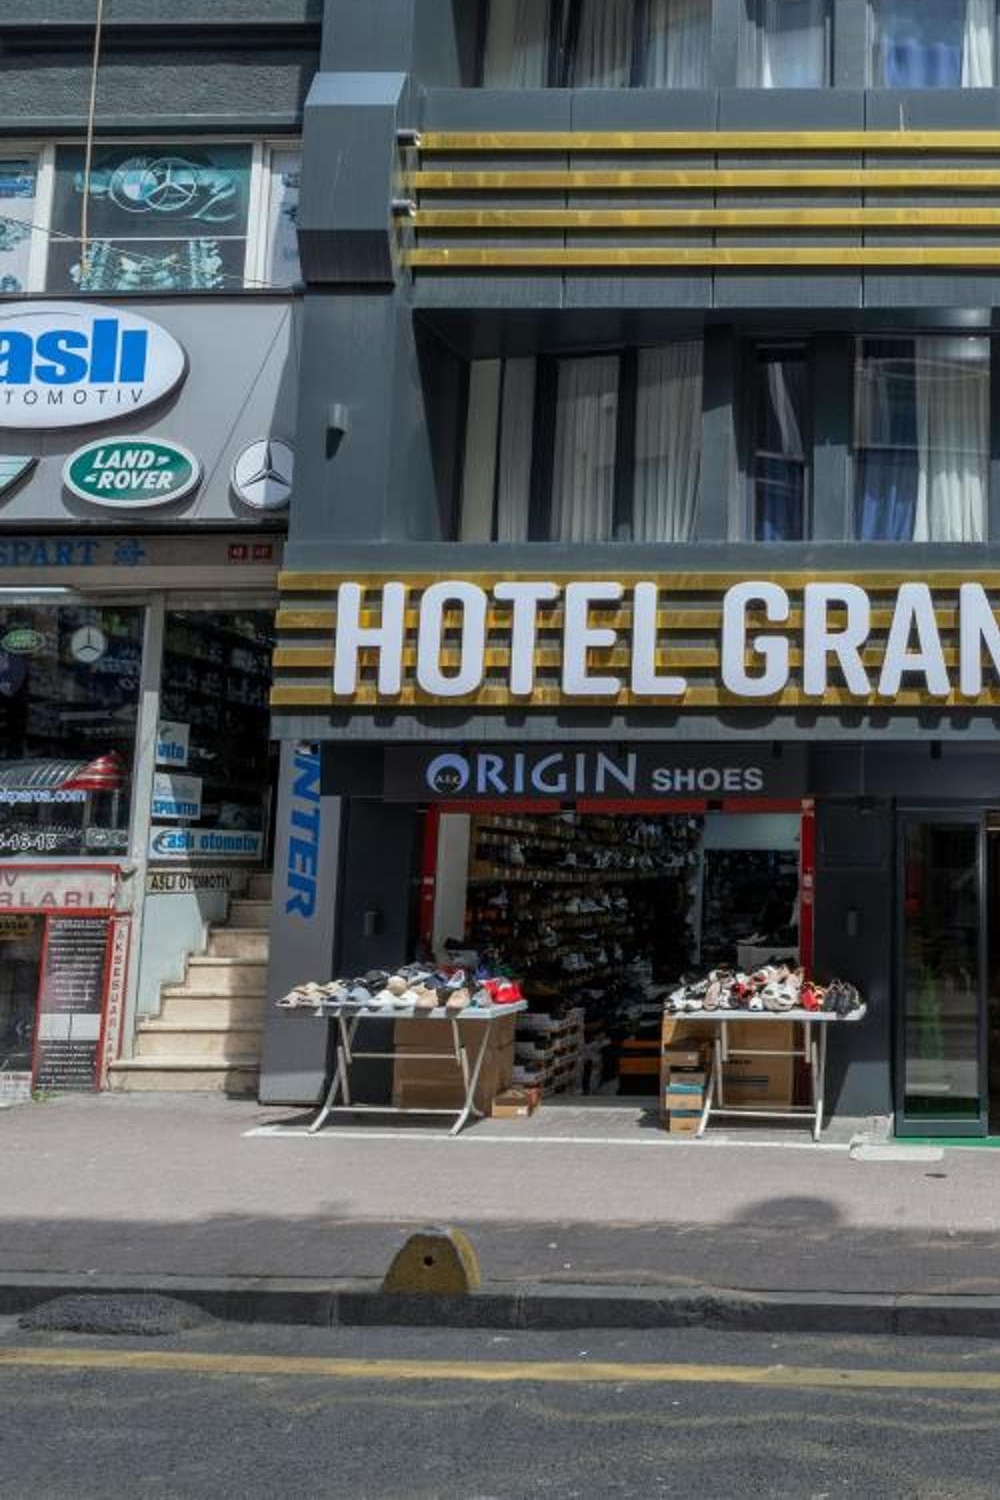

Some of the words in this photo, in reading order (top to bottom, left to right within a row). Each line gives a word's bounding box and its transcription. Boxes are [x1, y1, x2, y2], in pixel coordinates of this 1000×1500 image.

[92, 449, 155, 469] LAND
[96, 470, 174, 489] ROVER
[333, 580, 688, 696] HOTEL
[426, 752, 636, 794] ORIGIN
[651, 767, 763, 792] SHOES
